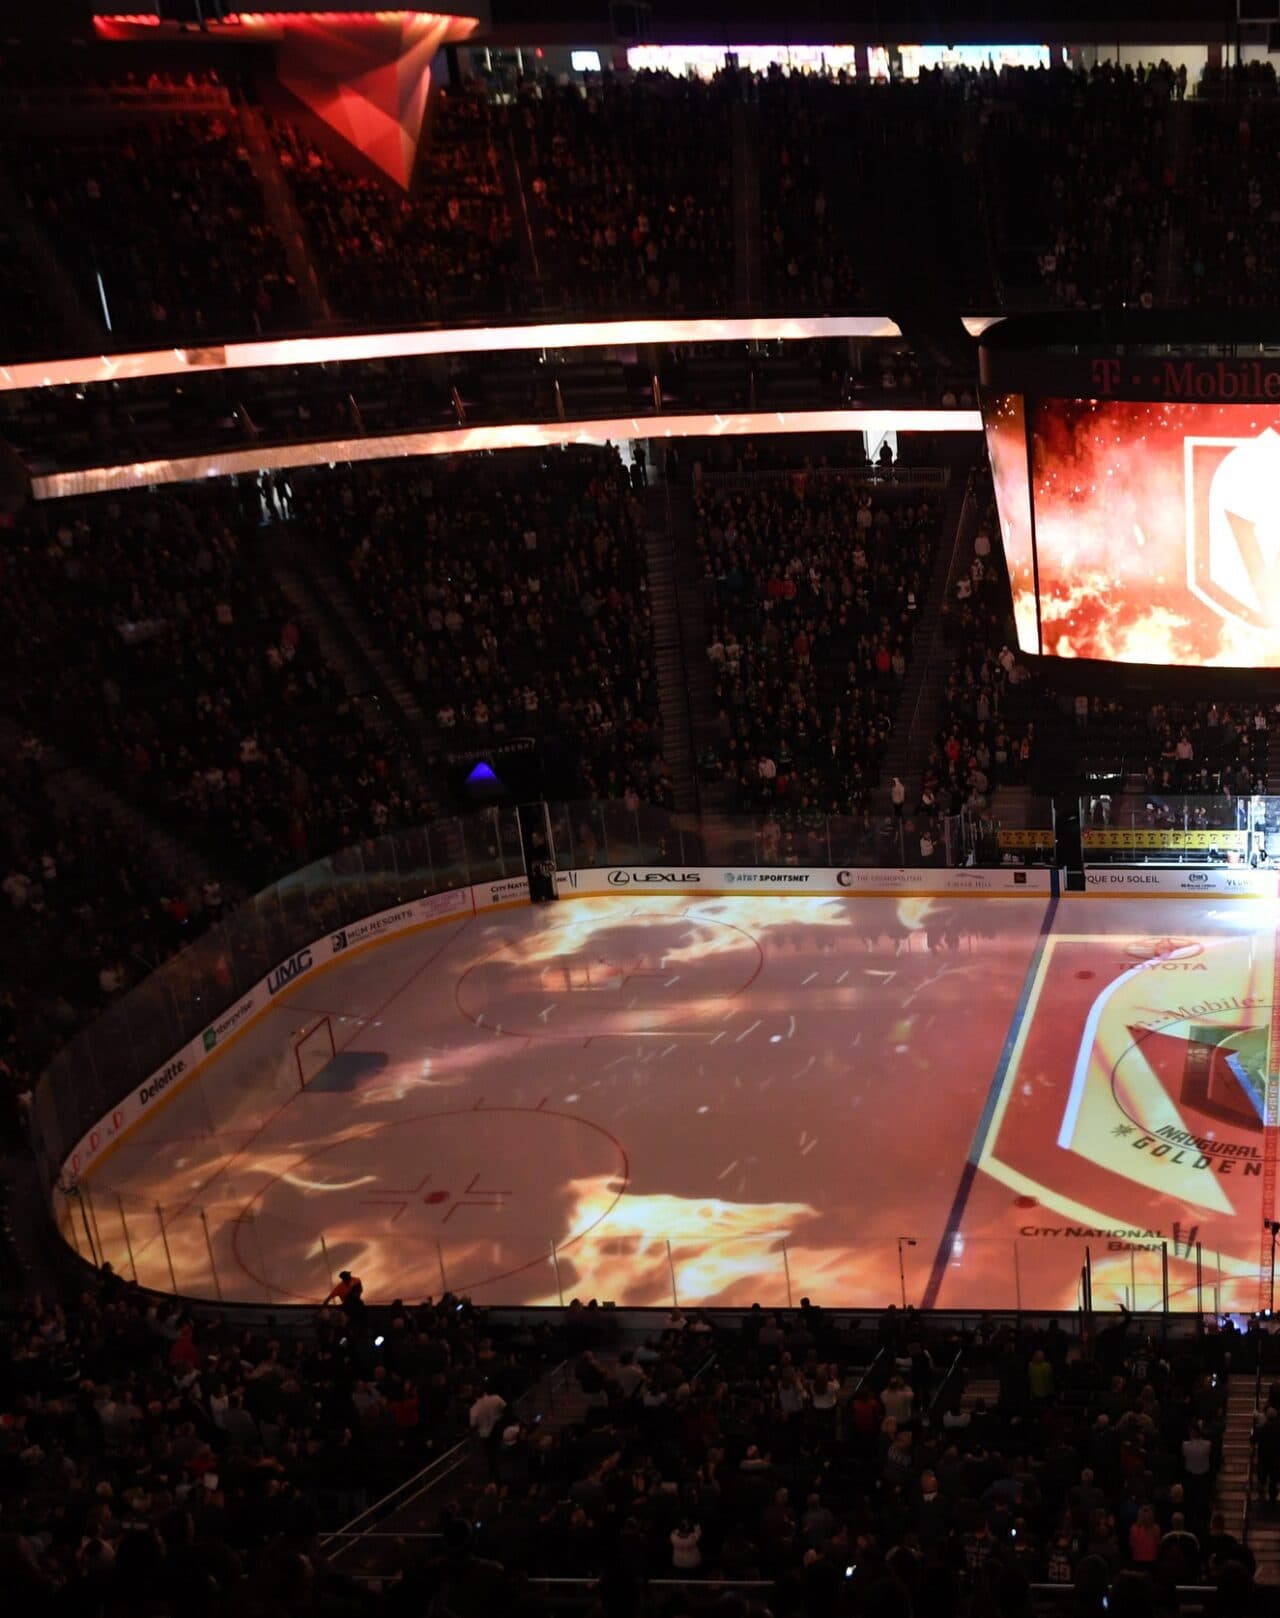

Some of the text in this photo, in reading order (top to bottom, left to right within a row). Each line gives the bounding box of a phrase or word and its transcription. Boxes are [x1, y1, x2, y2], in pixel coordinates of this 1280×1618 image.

[633, 873, 701, 883] LEXUS
[759, 875, 810, 883] SPORTSNET
[1126, 876, 1160, 884] SOLEIL
[369, 910, 413, 930] RESORTS
[267, 949, 313, 995] UMC
[1155, 1124, 1263, 1160] INAUGURAL
[1132, 1135, 1263, 1176] GOLDEN
[1020, 1226, 1167, 1239] CITY NATIONAL
